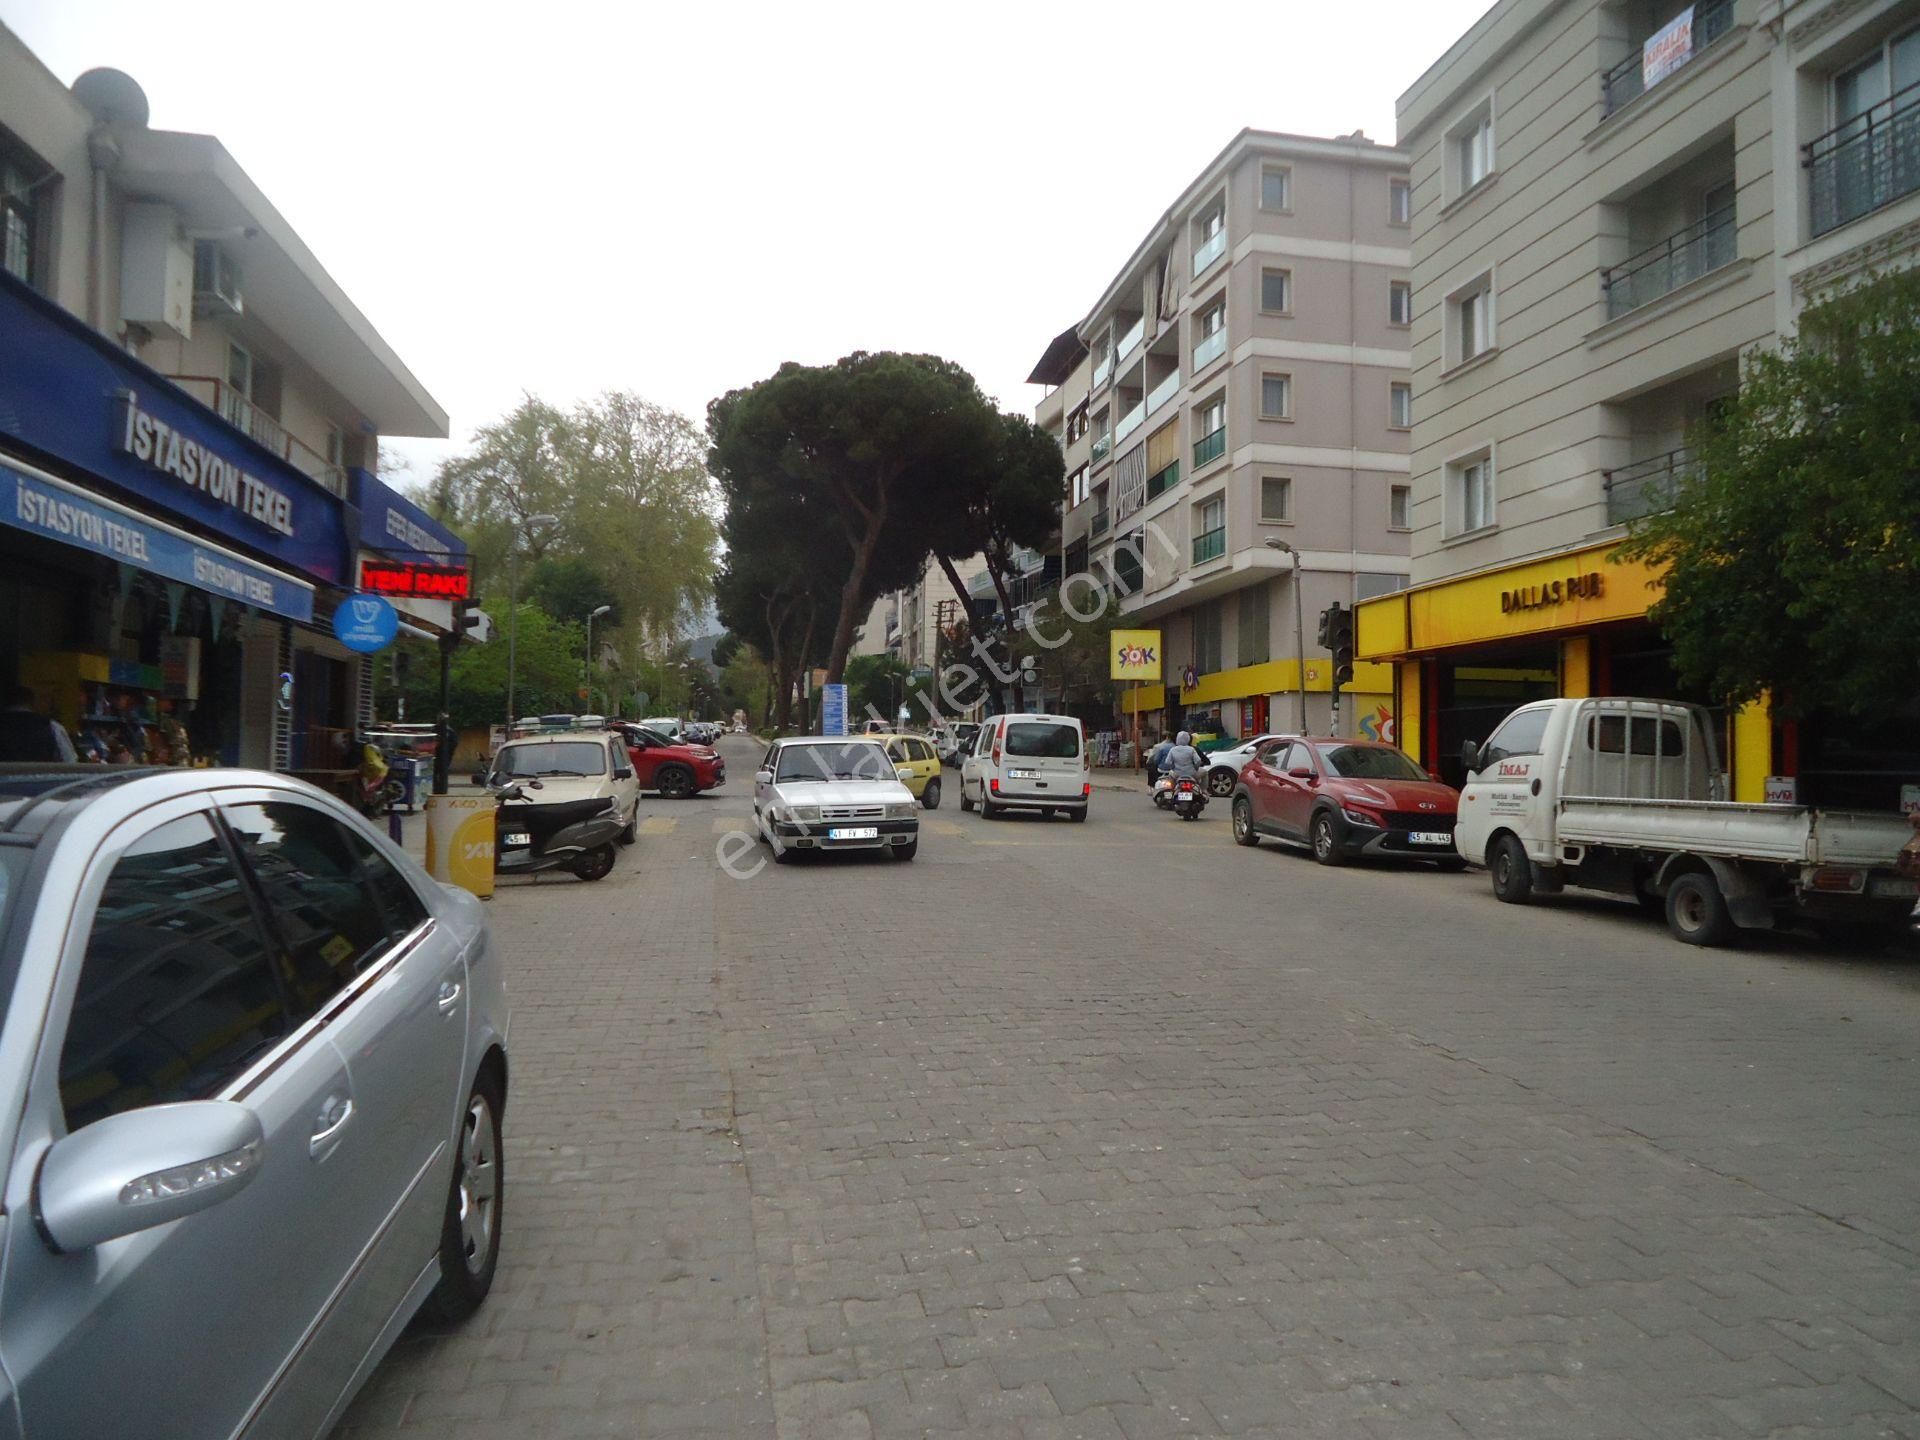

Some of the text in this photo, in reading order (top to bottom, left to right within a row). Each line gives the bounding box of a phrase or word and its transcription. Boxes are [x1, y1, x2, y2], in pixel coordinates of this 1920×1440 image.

[125, 390, 294, 536] İSTASYON TEKEL
[17, 478, 149, 562] İSTASYON TEKEL
[363, 566, 414, 592] YENİ
[1501, 573, 1605, 615] DALLAS PUB
